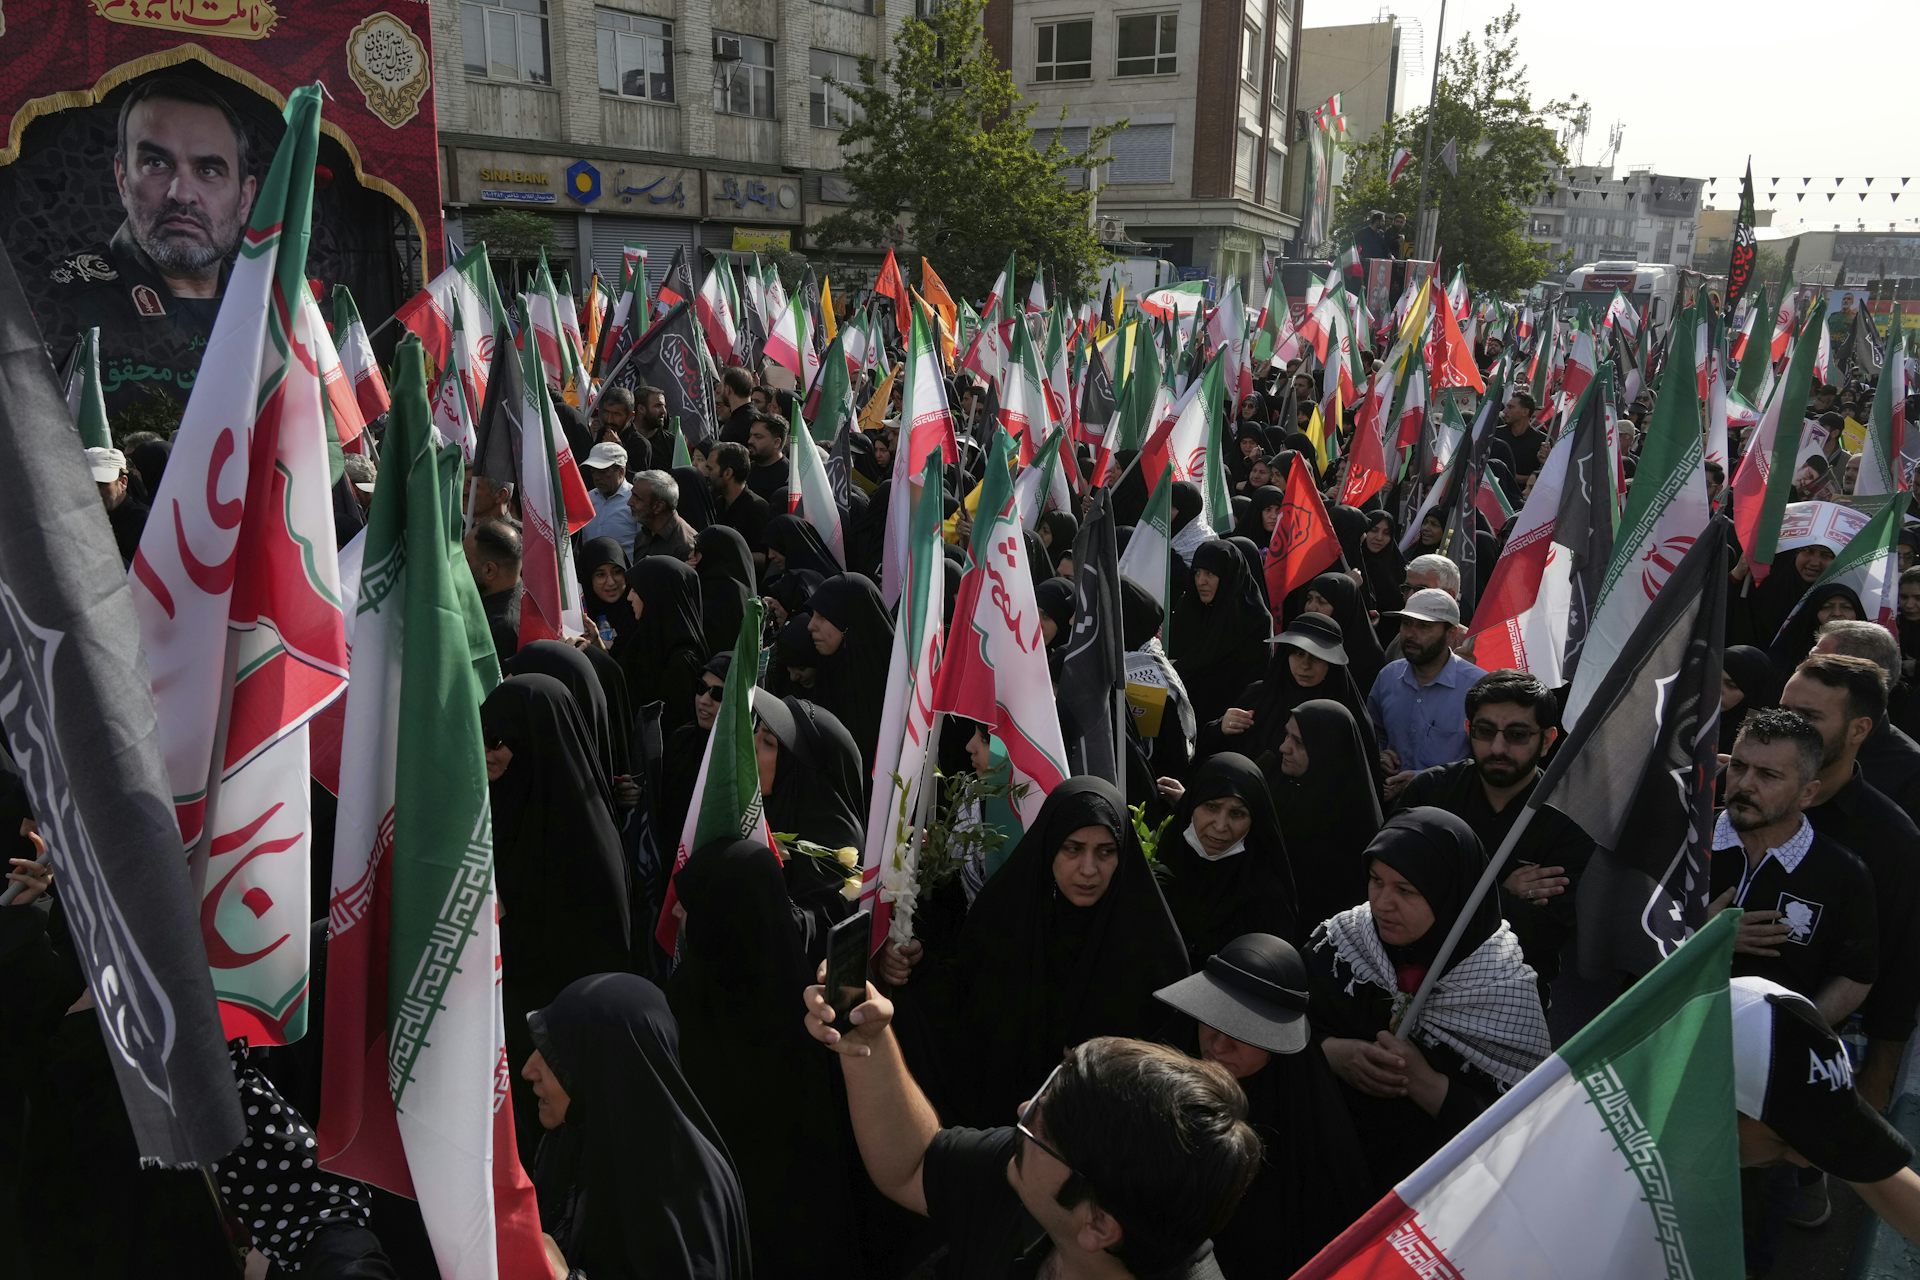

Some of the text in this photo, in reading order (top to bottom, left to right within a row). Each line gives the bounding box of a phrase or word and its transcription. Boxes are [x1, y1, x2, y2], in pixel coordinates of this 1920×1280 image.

[482, 168, 549, 186] SINA BANK
[102, 357, 173, 393] محقق
